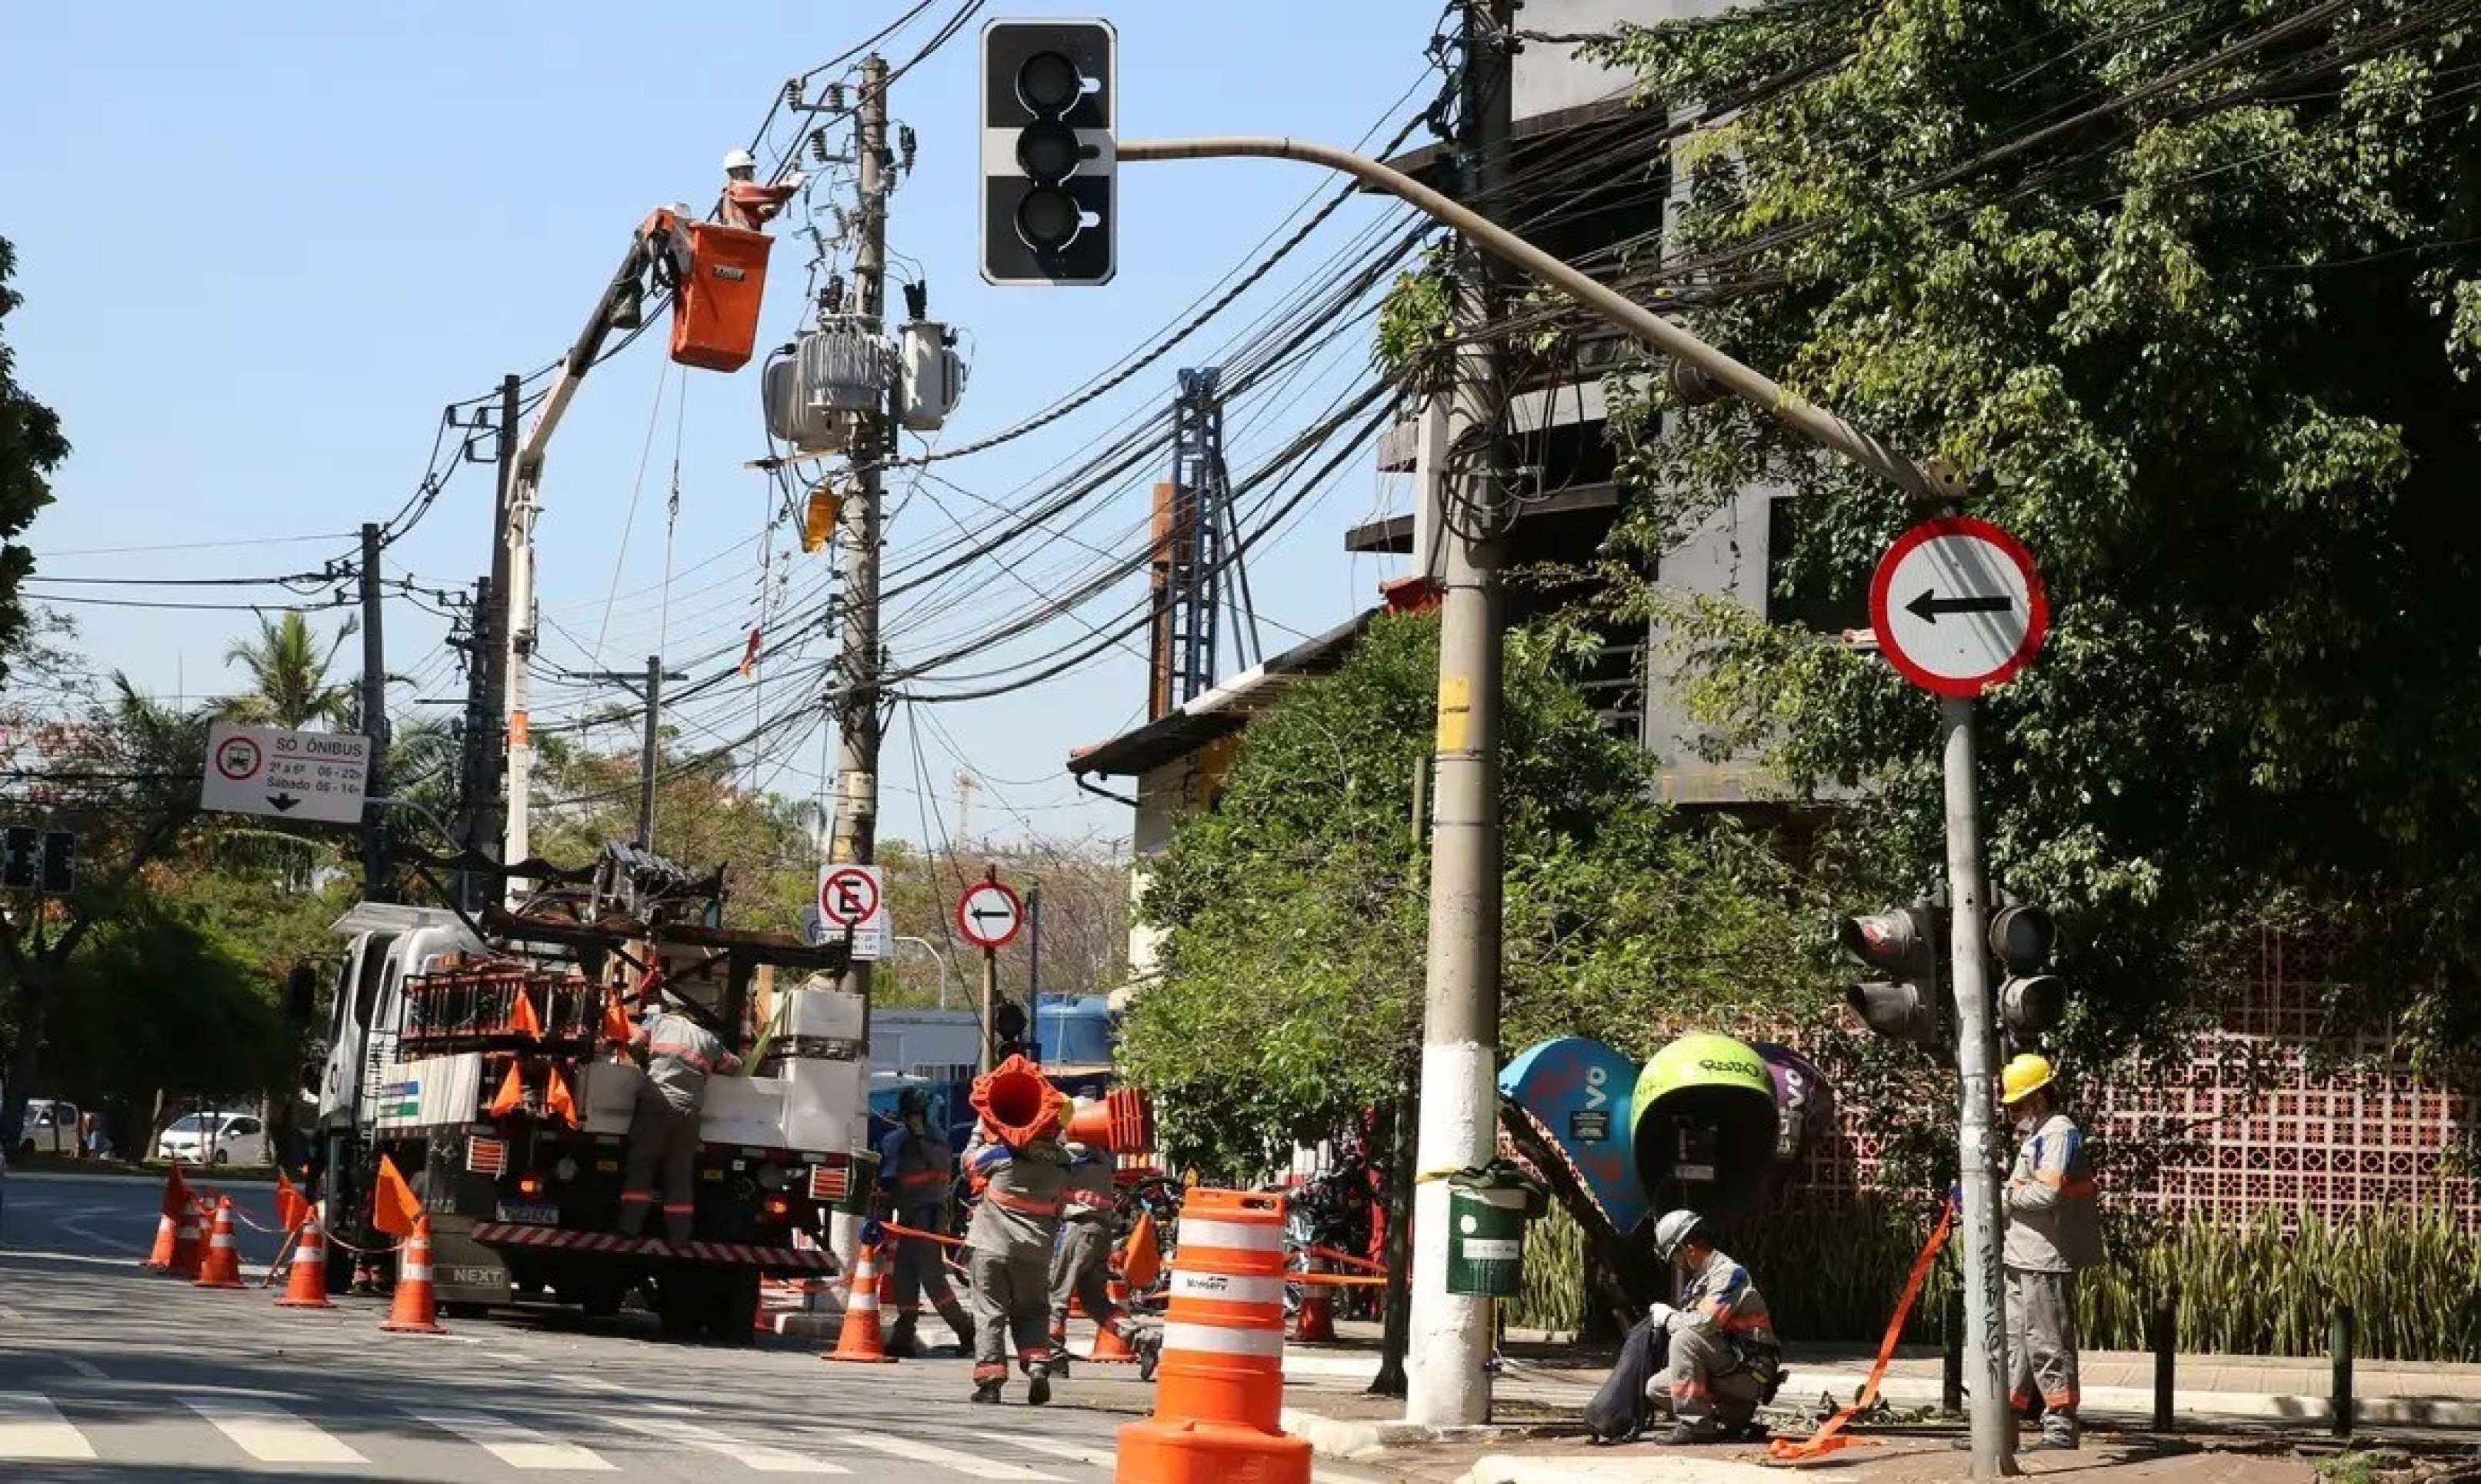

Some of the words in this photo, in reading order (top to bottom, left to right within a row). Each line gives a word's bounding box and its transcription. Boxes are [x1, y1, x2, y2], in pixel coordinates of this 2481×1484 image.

[276, 735, 298, 752] SÓ
[307, 738, 364, 758] ÔNIBUS
[266, 775, 310, 790] Sábado
[839, 879, 862, 914] E
[454, 1269, 501, 1282] NEXT
